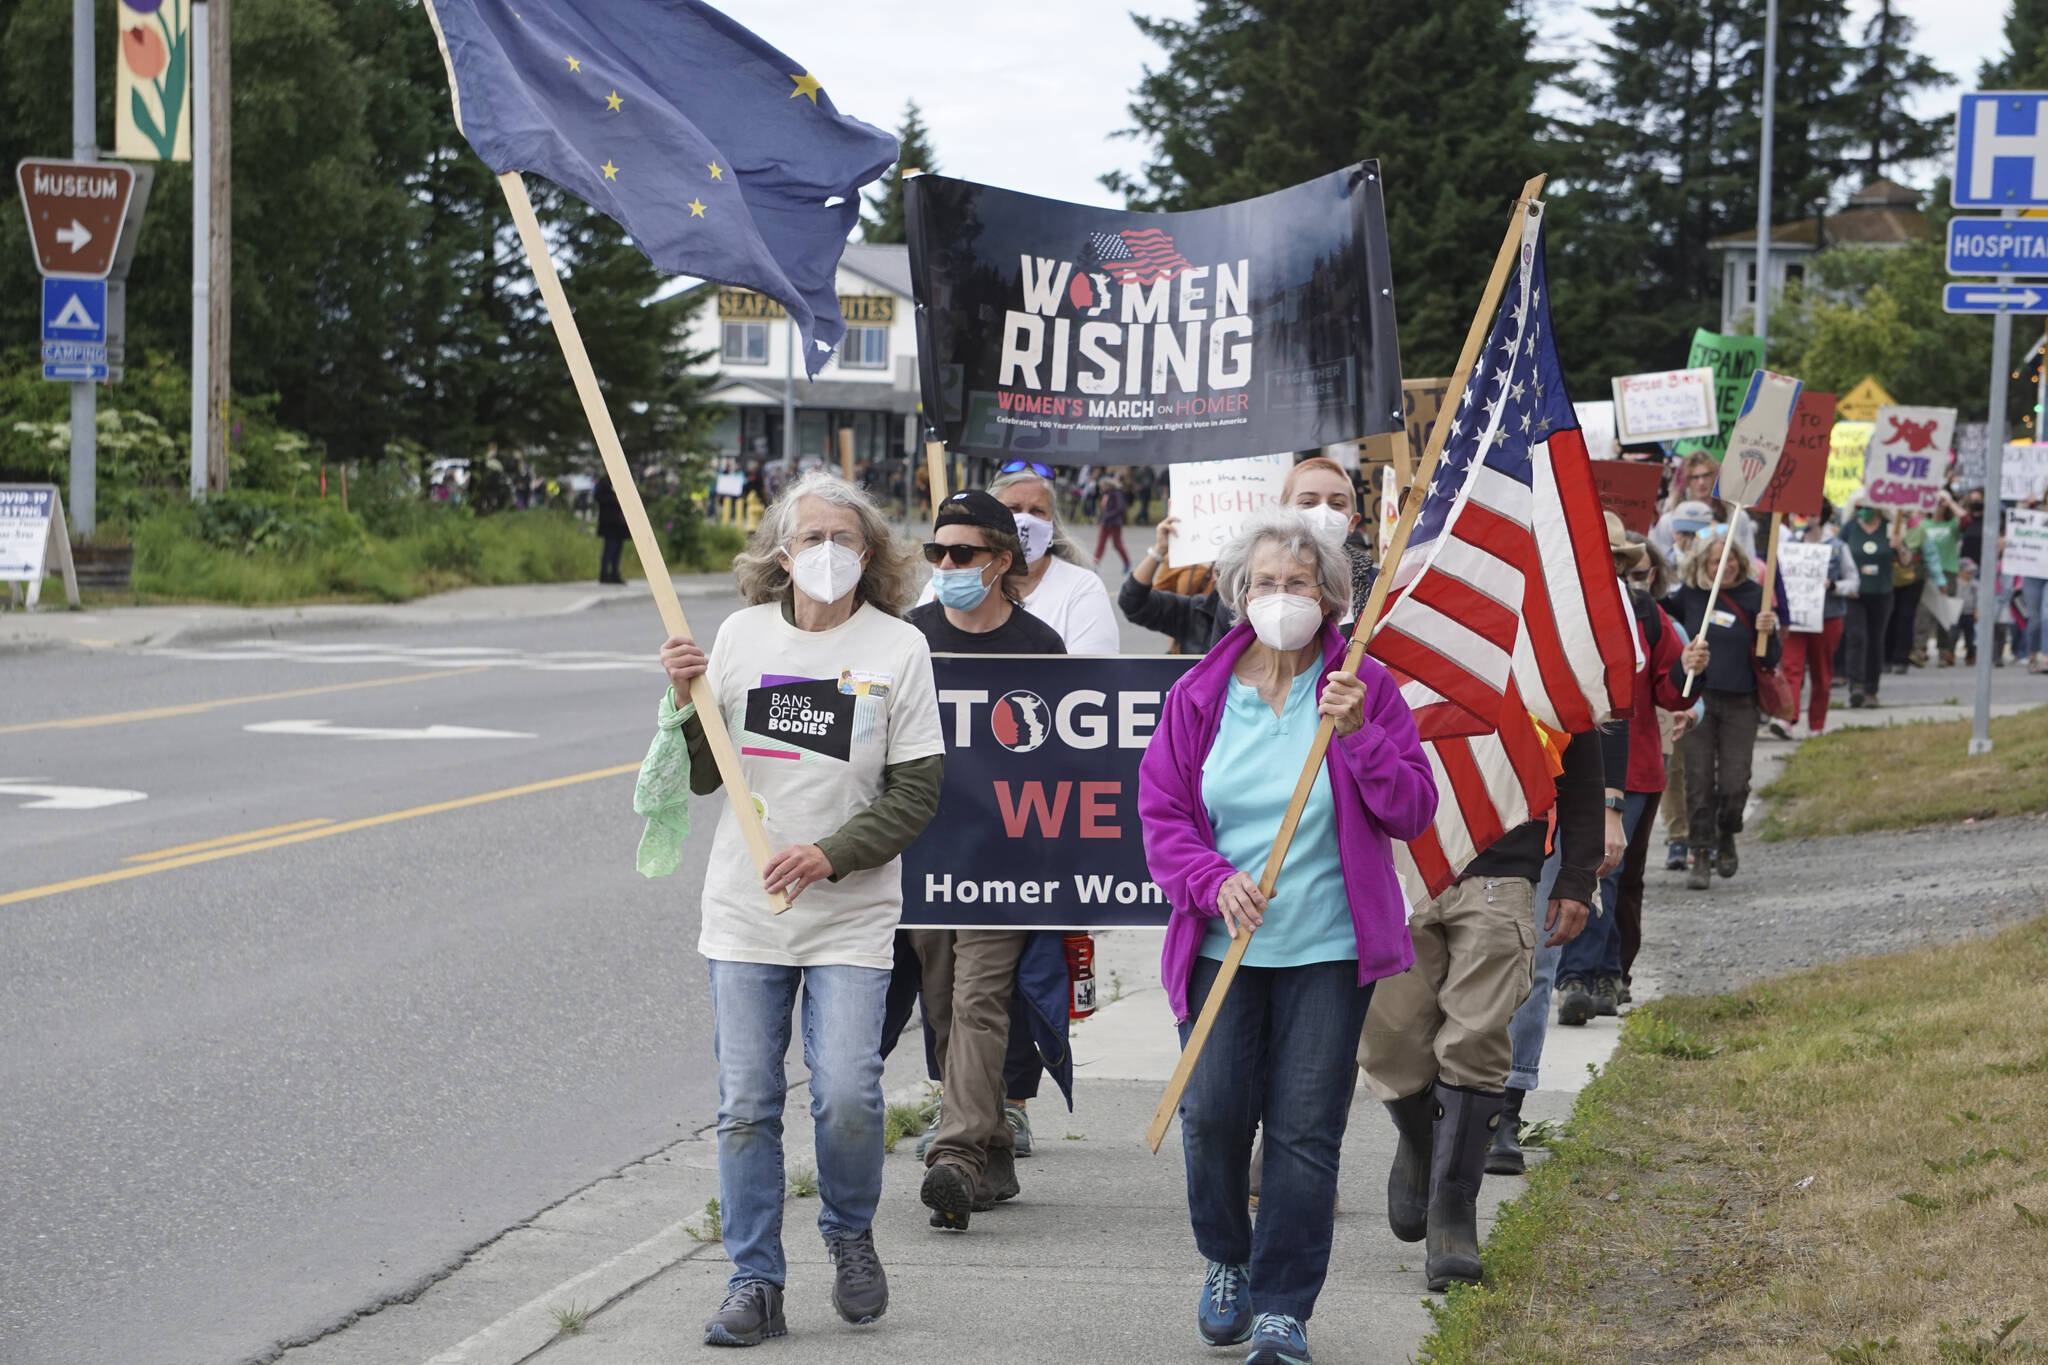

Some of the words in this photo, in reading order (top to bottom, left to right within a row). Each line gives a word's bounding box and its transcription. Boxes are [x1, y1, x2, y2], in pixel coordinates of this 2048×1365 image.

[34, 174, 118, 199] MUSEUM
[1021, 254, 1249, 323] WOMEN
[43, 345, 105, 361] CAMPING
[999, 310, 1252, 395] RISING
[998, 391, 1083, 417] WOMEN'S
[1088, 400, 1154, 418] MARCH
[1157, 405, 1173, 415] ON
[1176, 393, 1249, 416] HOMER
[996, 416, 1038, 429] Celebrating
[1039, 420, 1052, 428] 100
[1076, 423, 1120, 432] Anniversary
[1164, 421, 1183, 431] Right
[1184, 421, 1192, 429] to
[1193, 420, 1209, 428] Vote
[1210, 419, 1218, 427] in
[1218, 417, 1248, 426] America
[1886, 453, 1931, 478] VOTE
[1869, 479, 1938, 509] COUNTS
[1208, 524, 1244, 546] GU
[771, 693, 812, 708] BANS
[768, 718, 828, 736] BODIES
[769, 706, 799, 720] OFF
[799, 708, 835, 725] OUR
[938, 689, 1168, 753] TOGE
[993, 780, 1122, 838] WE
[925, 873, 1060, 904] Homer
